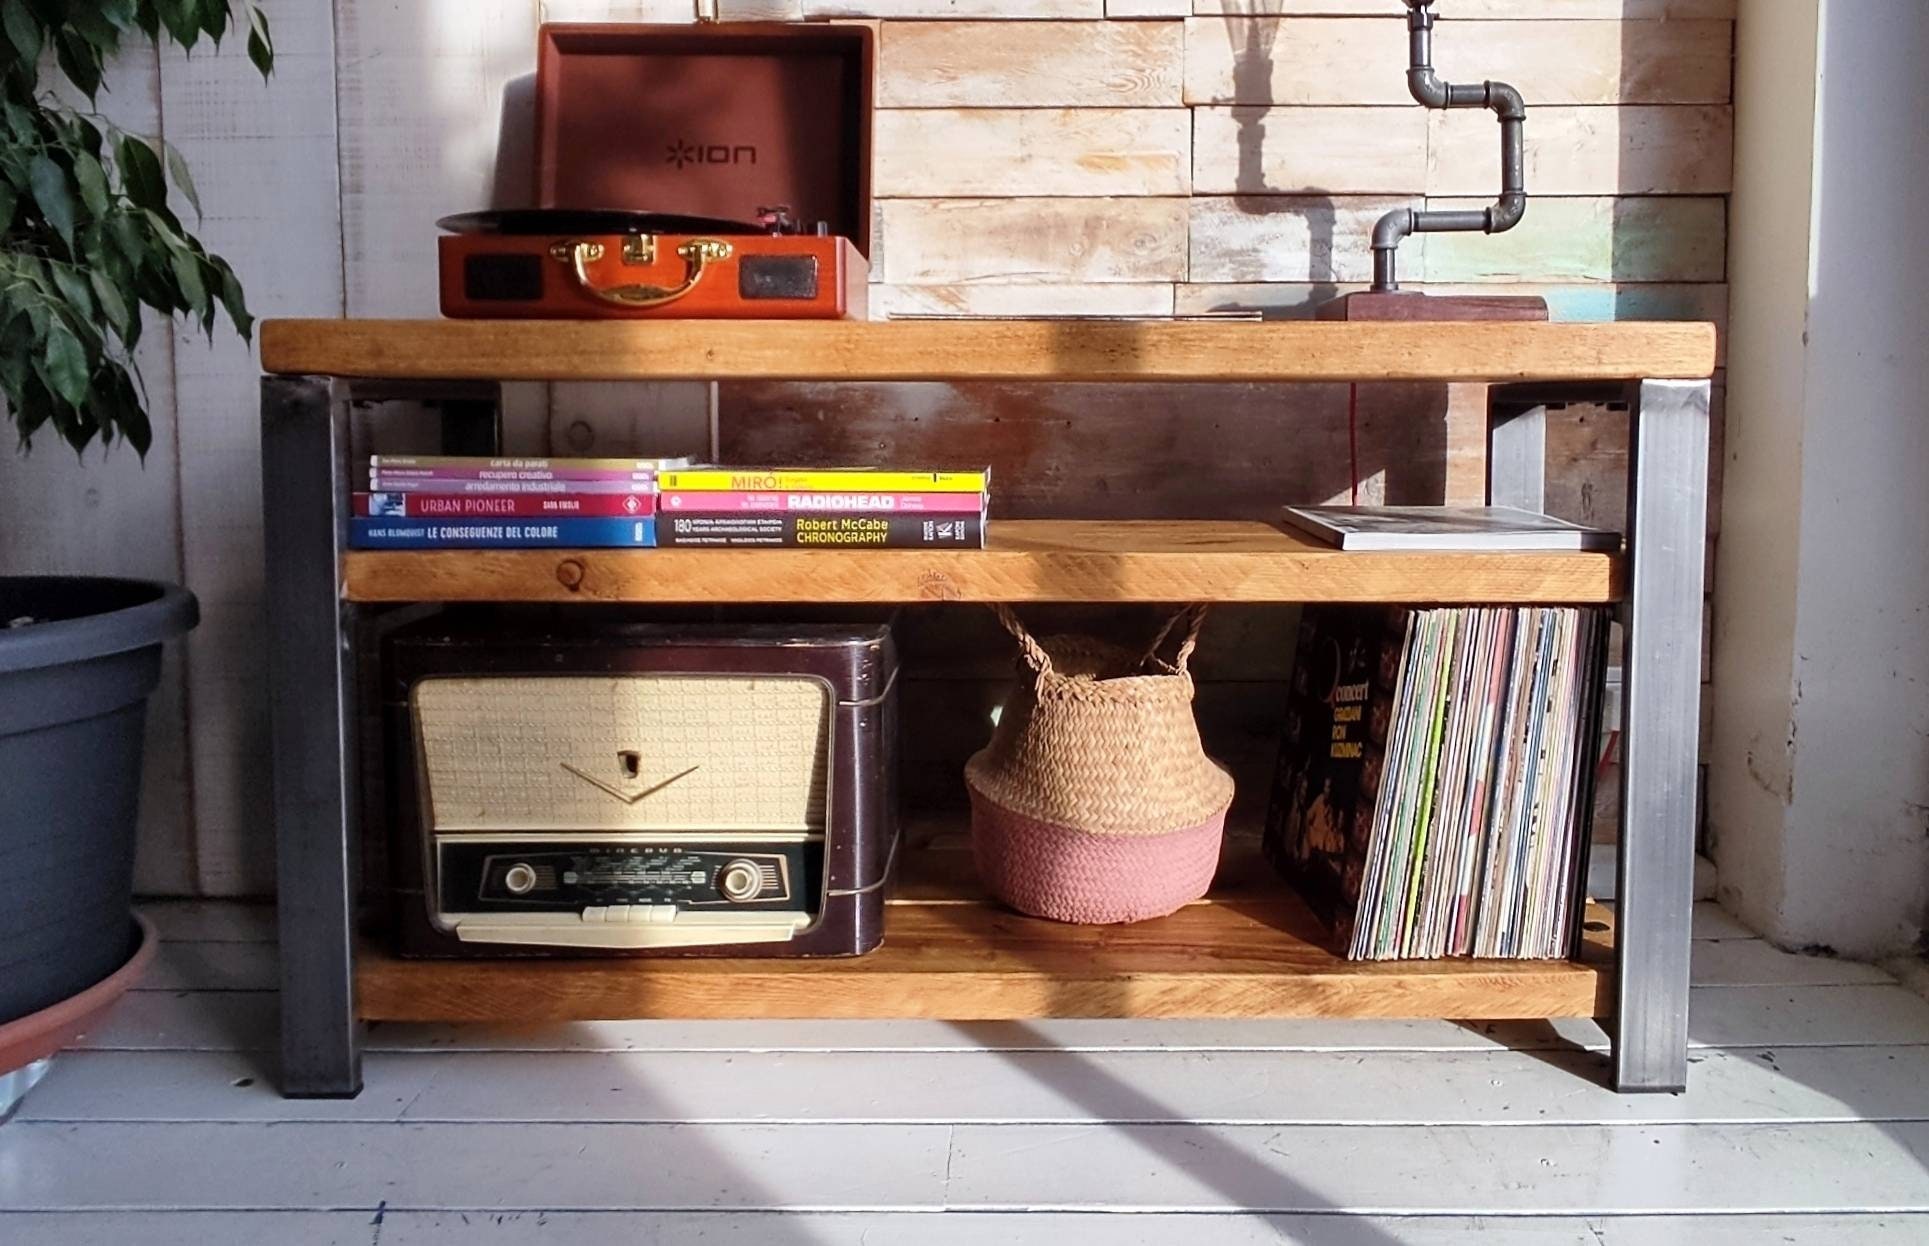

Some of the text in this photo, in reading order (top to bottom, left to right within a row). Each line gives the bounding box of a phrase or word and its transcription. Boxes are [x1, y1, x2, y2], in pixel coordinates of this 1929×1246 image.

[491, 459, 511, 468] carta
[513, 459, 523, 467] da
[479, 470, 553, 480] recupero creativo
[465, 482, 565, 492] arredamento industriale
[420, 499, 515, 512] URBAN PIONEER
[787, 495, 895, 509] RADIOHEAD
[674, 519, 692, 533] 180
[796, 518, 837, 531] Robert
[841, 518, 888, 531] McCabe
[368, 528, 386, 537] HANS
[427, 526, 558, 539] LE CONSEGUENZE DEL COLORE
[796, 532, 888, 543] CHRONOGRAPHY
